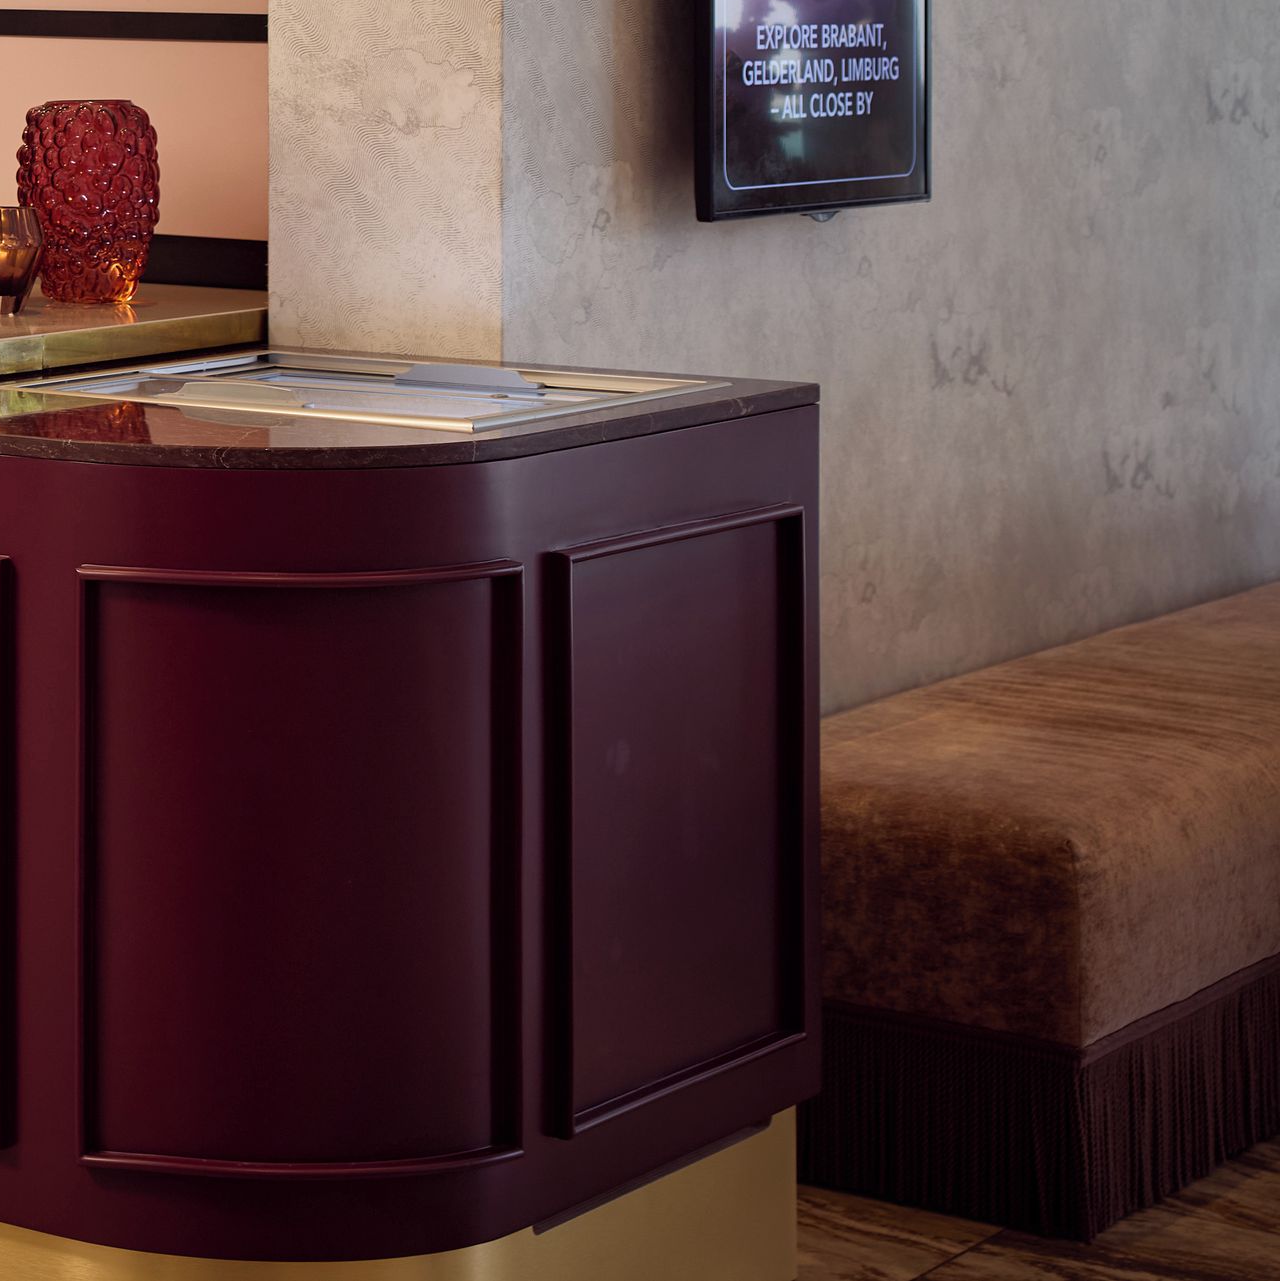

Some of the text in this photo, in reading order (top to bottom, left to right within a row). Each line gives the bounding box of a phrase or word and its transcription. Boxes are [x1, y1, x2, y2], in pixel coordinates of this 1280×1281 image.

[756, 23, 887, 50] EXPLORE BRABANT,
[742, 56, 899, 86] GELDERLAND, LIMBURG
[782, 94, 807, 119] ALL
[809, 92, 853, 118] CLOSE
[856, 91, 873, 115] BY
